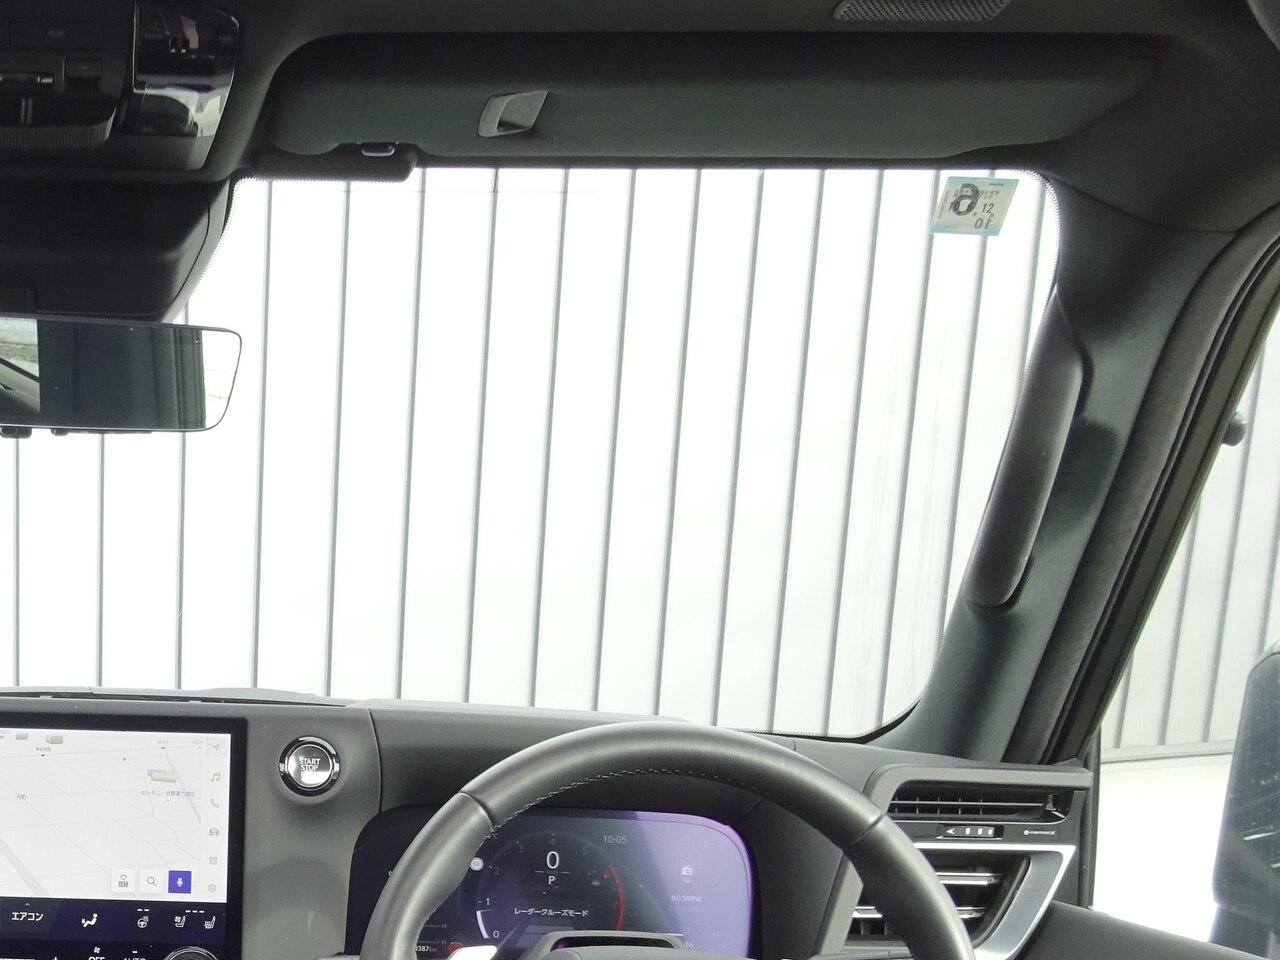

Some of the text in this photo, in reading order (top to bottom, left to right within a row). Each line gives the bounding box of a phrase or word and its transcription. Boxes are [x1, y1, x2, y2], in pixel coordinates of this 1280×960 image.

[602, 835, 628, 845] 10:05
[546, 850, 560, 869] 0
[548, 875, 556, 885] P
[11, 911, 44, 922] エアコン
[514, 908, 588, 917] レーダークルーズモード
[492, 930, 500, 939] 0
